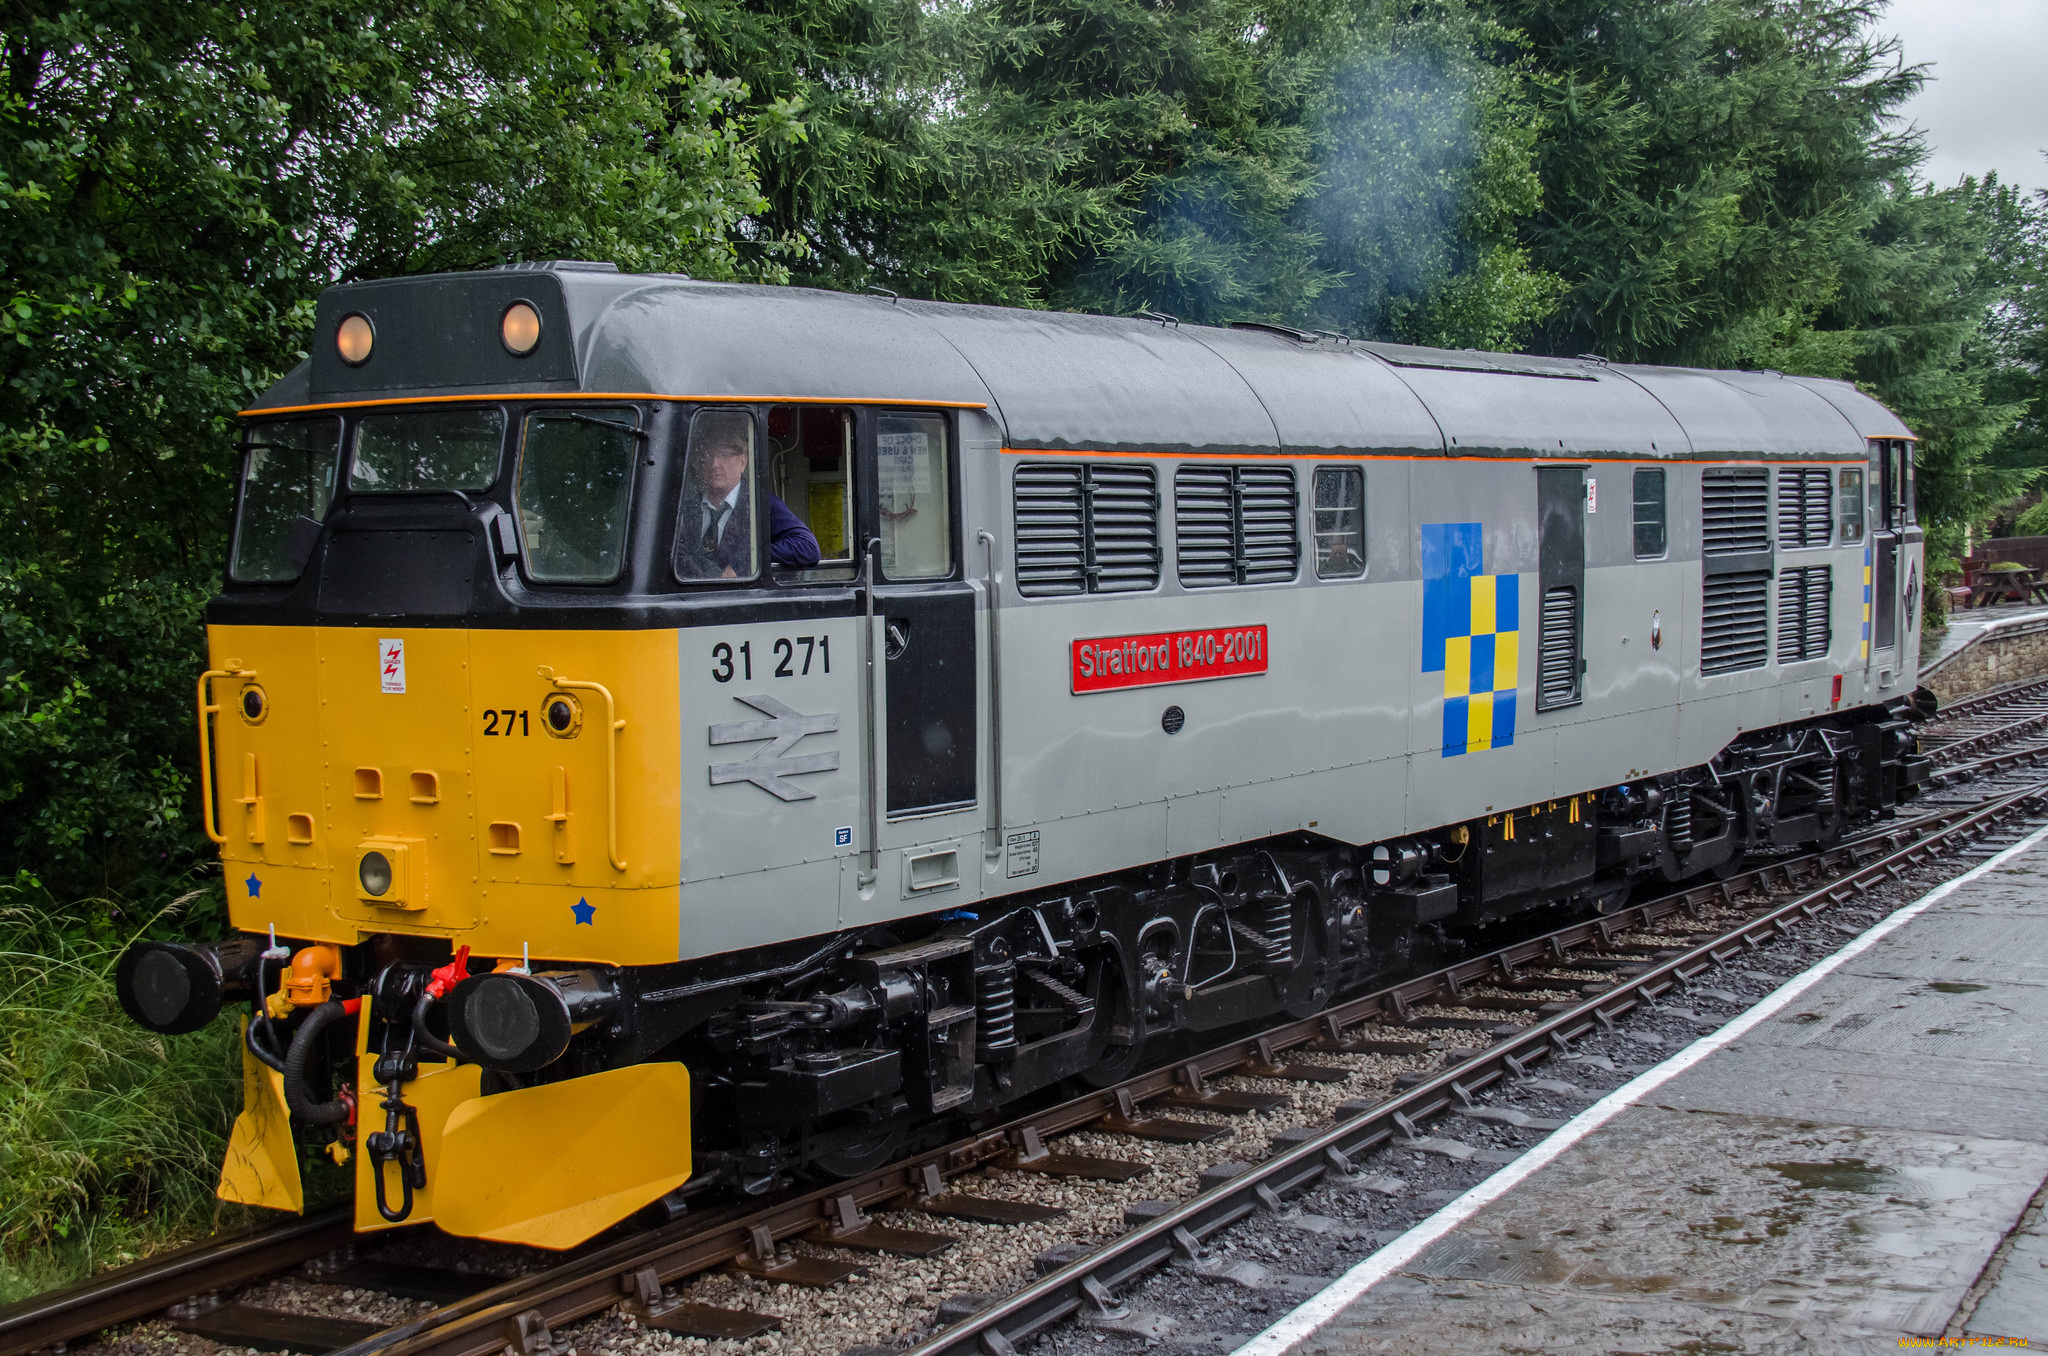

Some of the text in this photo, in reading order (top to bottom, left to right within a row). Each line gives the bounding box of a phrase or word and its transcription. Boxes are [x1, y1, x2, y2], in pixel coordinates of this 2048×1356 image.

[712, 635, 830, 683] 31 271
[1080, 630, 1262, 678] Stratford 1840-2001
[483, 709, 529, 736] 271
[840, 834, 848, 843] SF
